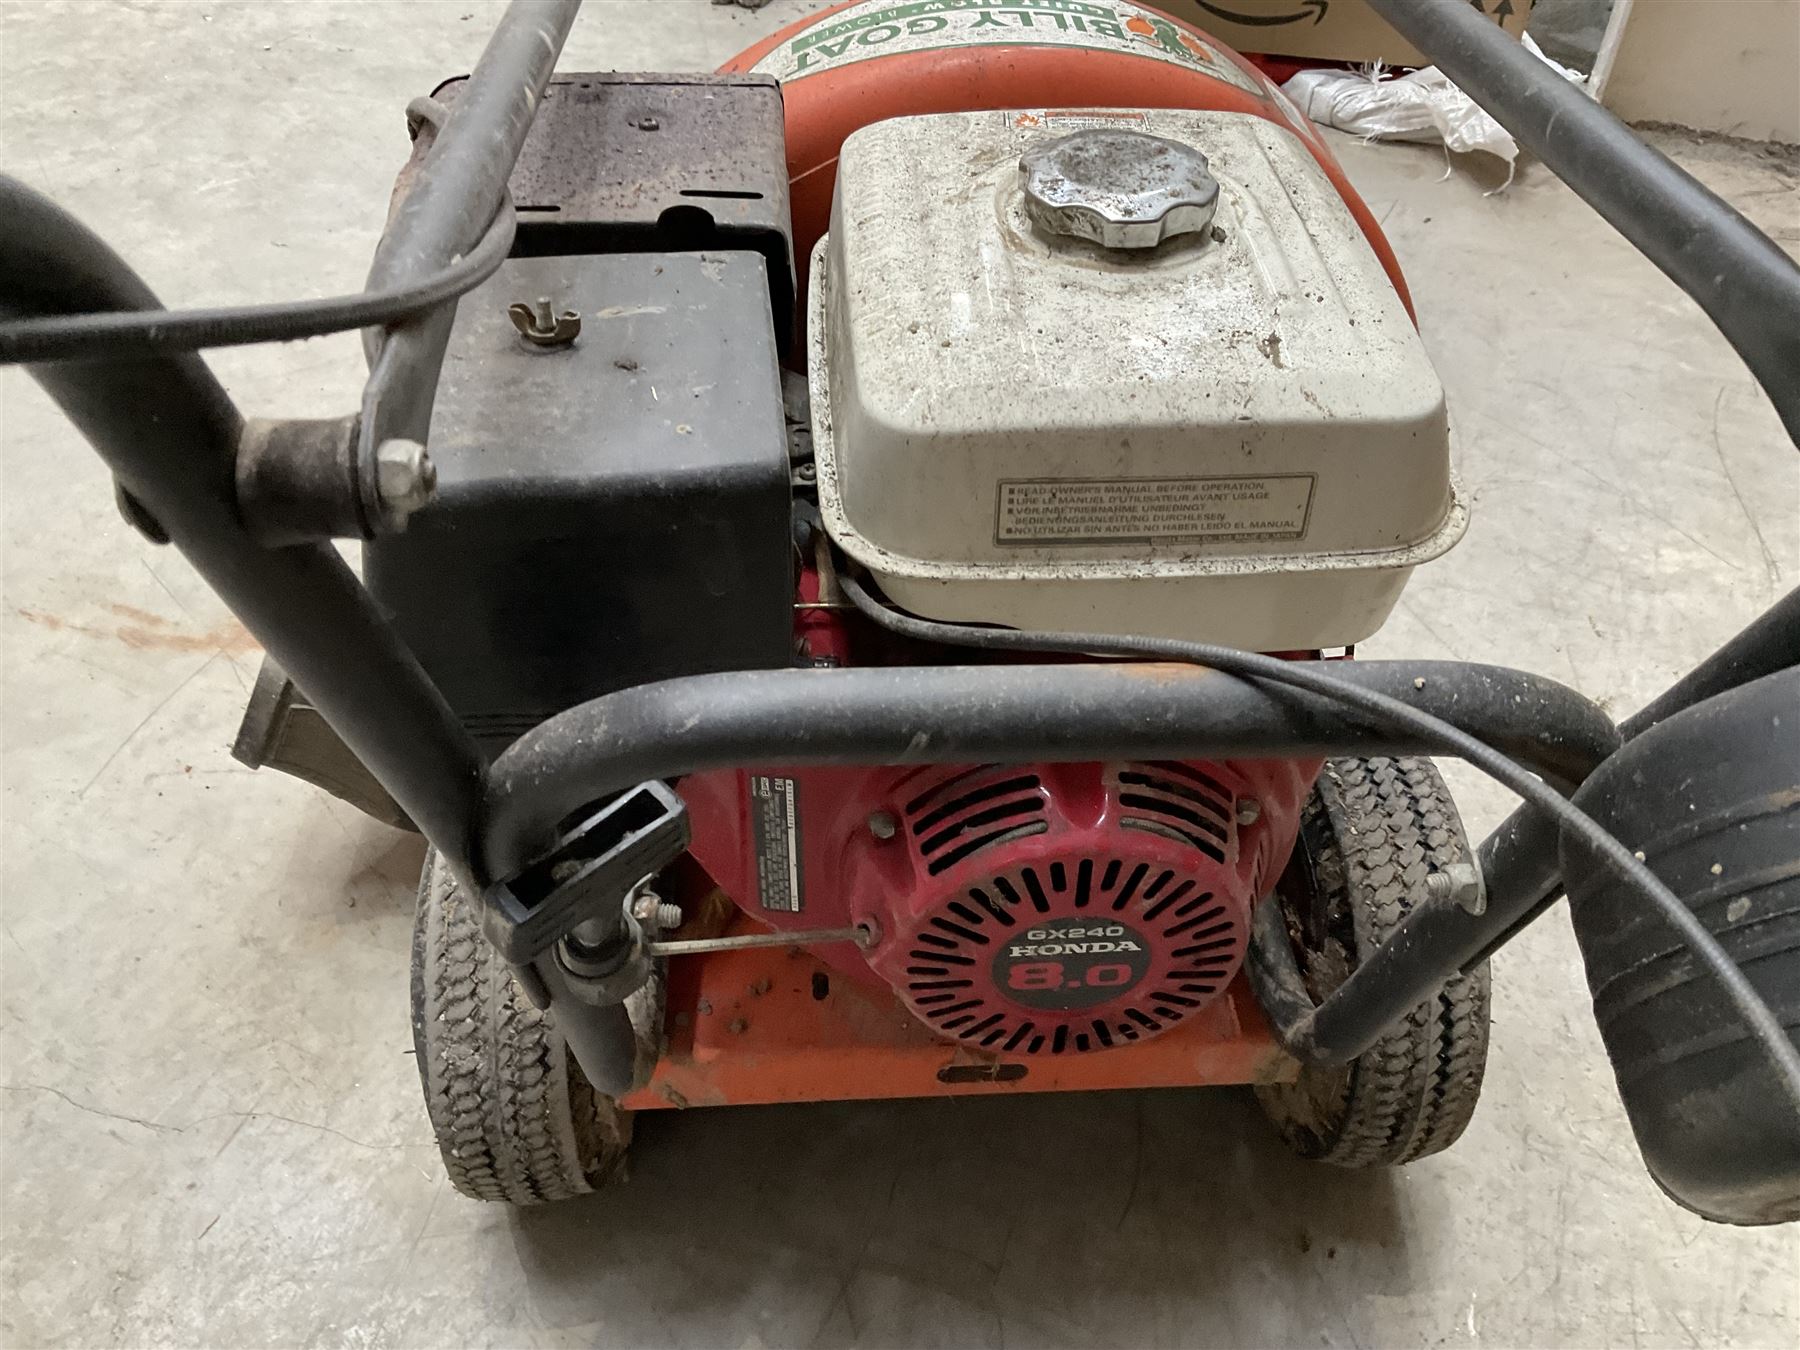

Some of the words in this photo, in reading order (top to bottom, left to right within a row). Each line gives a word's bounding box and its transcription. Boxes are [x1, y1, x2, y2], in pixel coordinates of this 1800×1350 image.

[807, 10, 898, 43] BLOWER
[969, 10, 1128, 41] BILLY
[785, 16, 949, 77] GOAT
[1017, 487, 1047, 496] READ
[1051, 486, 1101, 496] OWNER'S
[1104, 485, 1151, 494] MANUAL
[1156, 484, 1198, 492] BEFORE
[1201, 482, 1265, 491] OPERATION
[1016, 496, 1038, 505] LIRE
[1042, 496, 1056, 504] LE
[1058, 496, 1105, 504] MANUEL
[1108, 494, 1191, 503] D'UTILISATEUR
[1192, 493, 1229, 502] AVANT
[1232, 491, 1270, 500] USAGE
[1141, 503, 1206, 512] UNBEDINGT
[1153, 513, 1226, 522] DURCHLESEN
[1083, 525, 1101, 533] SIN
[1104, 525, 1140, 533] ANTES
[1143, 524, 1160, 532] NO
[1162, 523, 1198, 531] HABER
[1200, 522, 1232, 530] LEIDO
[1234, 521, 1246, 529] EL
[1249, 520, 1297, 529] MANUAL
[1027, 926, 1124, 941] GX240
[1009, 940, 1141, 957] HONDA
[1008, 962, 1132, 990] 8.0
